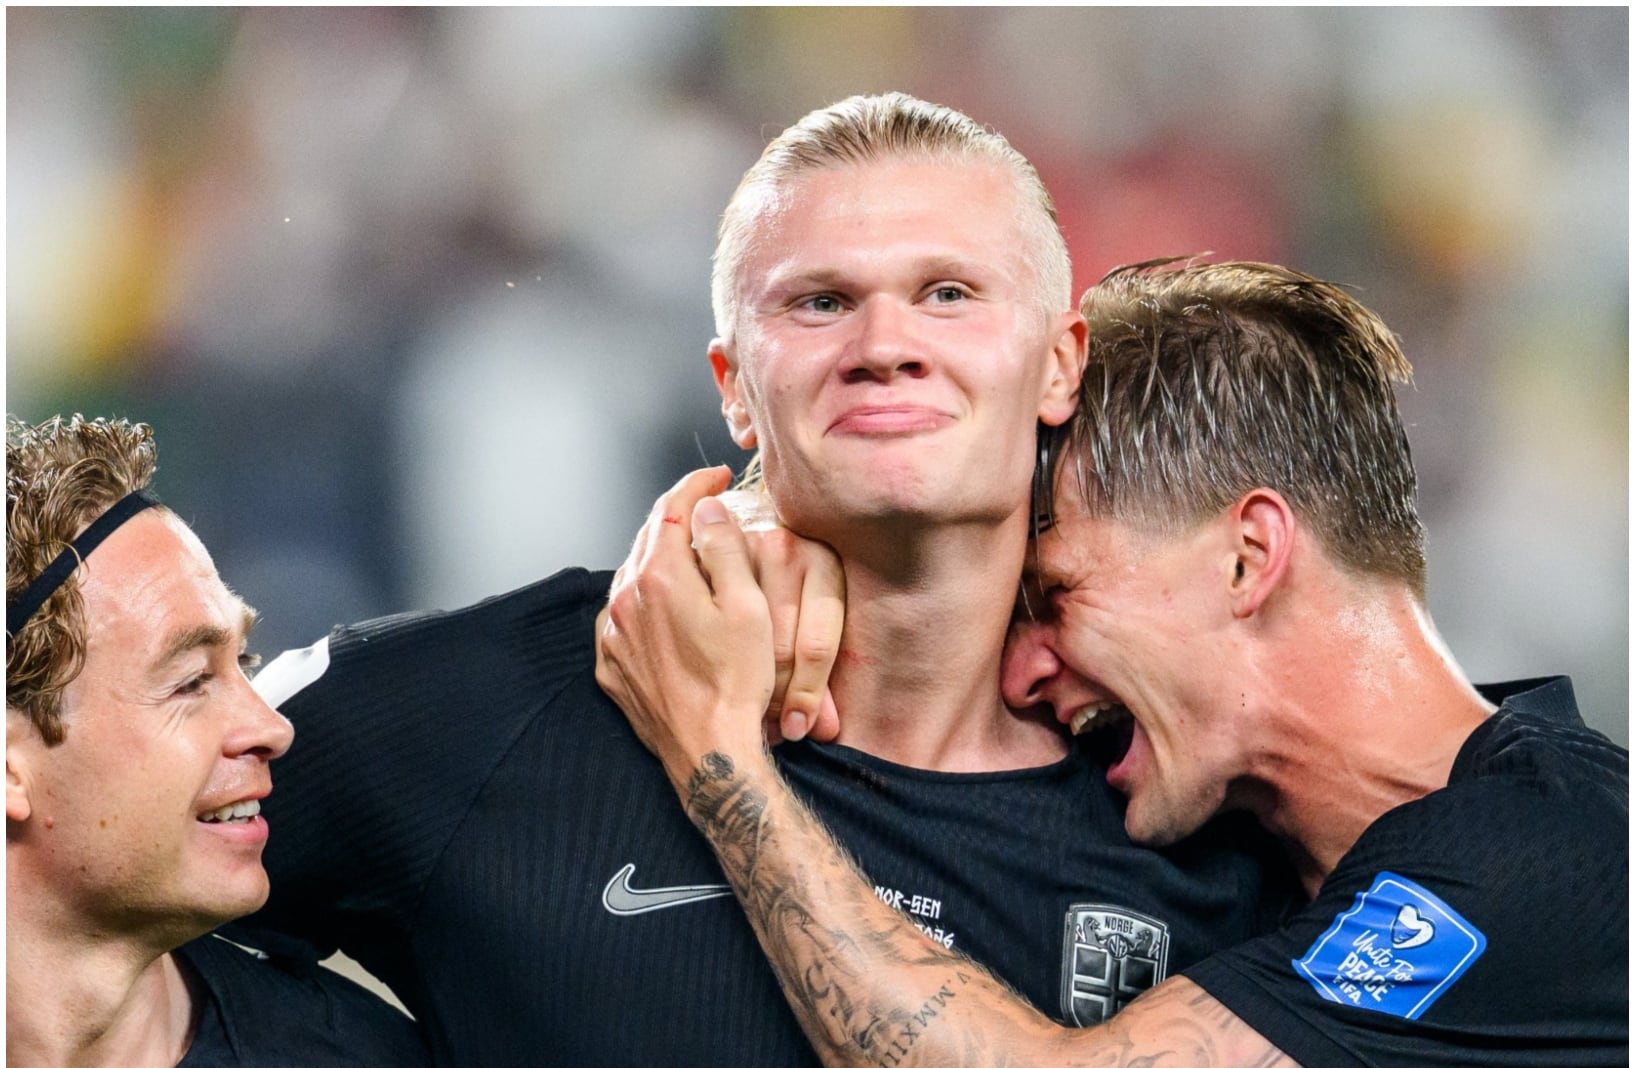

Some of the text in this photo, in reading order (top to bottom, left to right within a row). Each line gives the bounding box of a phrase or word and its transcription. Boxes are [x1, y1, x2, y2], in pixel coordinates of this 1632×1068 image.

[874, 886, 942, 920] NOR-SEN
[1104, 915, 1134, 935] NORGE
[1337, 951, 1396, 1002] PEACE
[1352, 929, 1415, 982] Unite For
